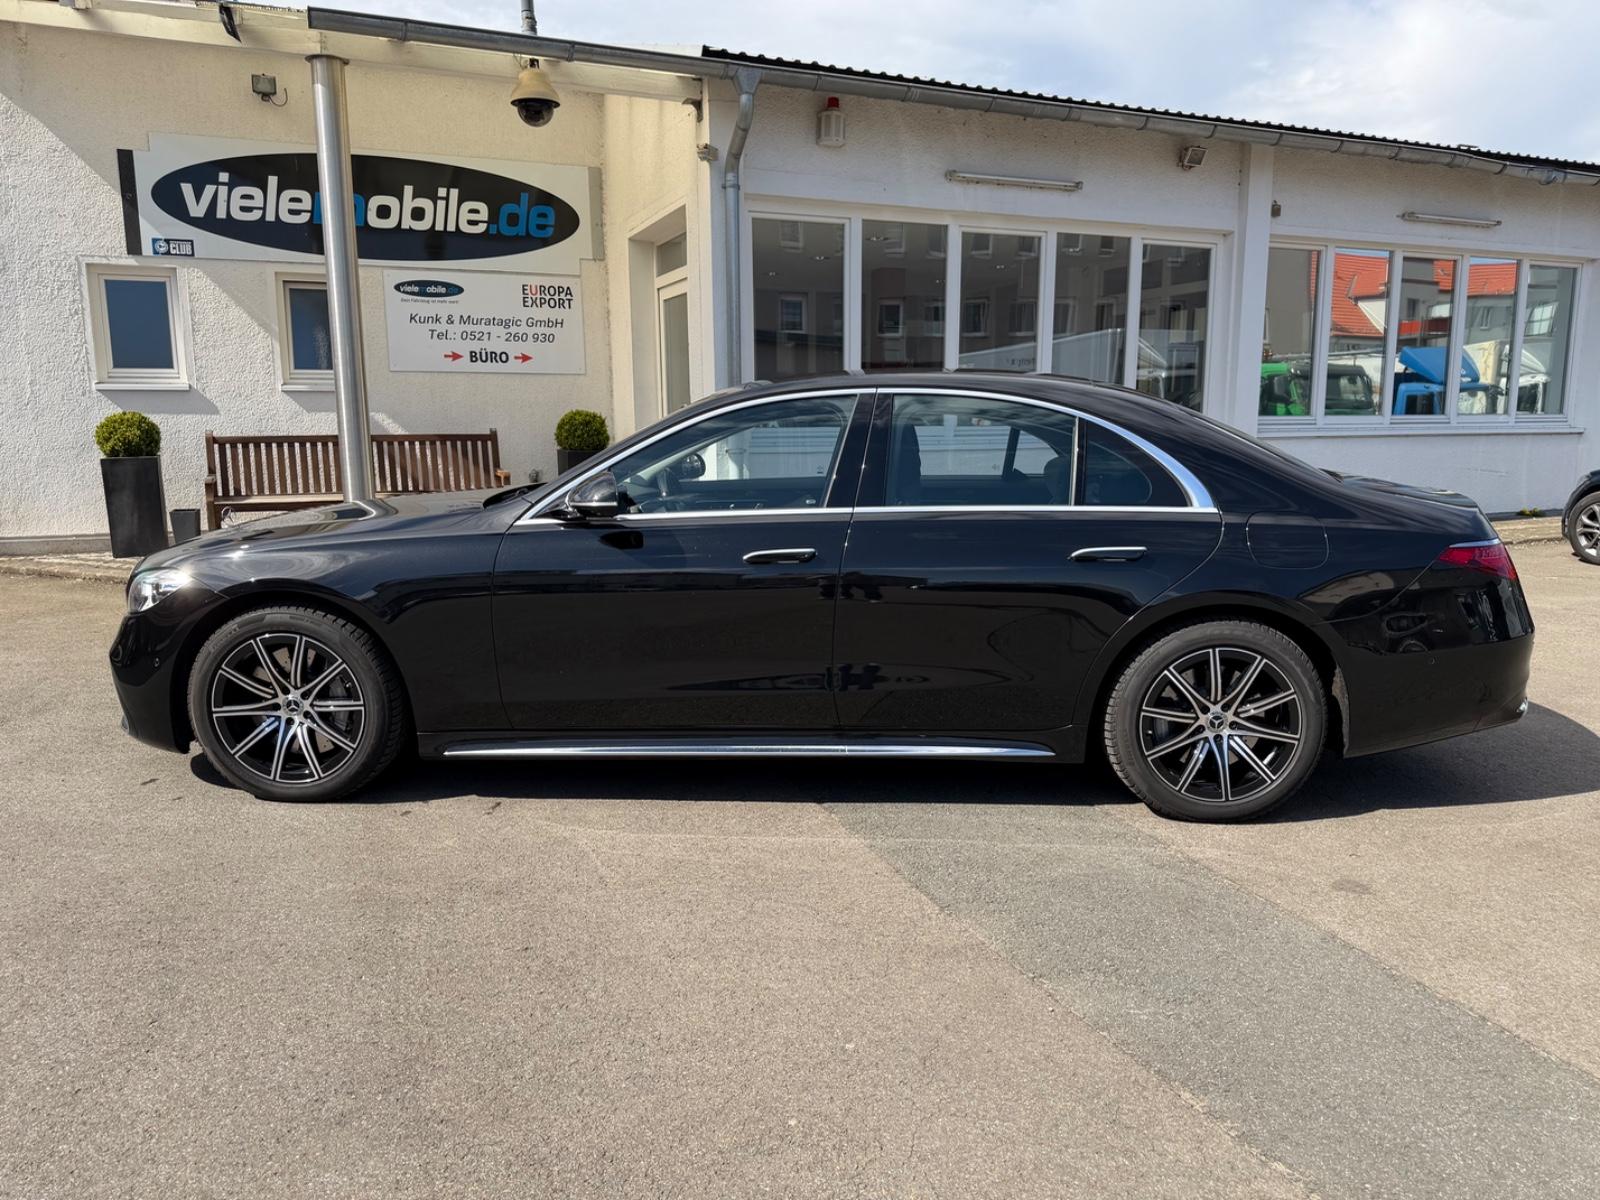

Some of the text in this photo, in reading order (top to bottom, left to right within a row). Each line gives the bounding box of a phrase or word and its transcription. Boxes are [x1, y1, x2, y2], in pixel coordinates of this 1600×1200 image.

[170, 243, 193, 255] CLUB
[522, 284, 573, 297] EUROPA
[523, 297, 573, 309] EXPORT
[409, 313, 564, 329] Kunk & Muratagic GmbH
[429, 329, 456, 341] Tel.:
[460, 330, 492, 341] 0521
[504, 332, 528, 343] 260
[532, 332, 555, 343] 930
[469, 348, 509, 363] BÜRO
